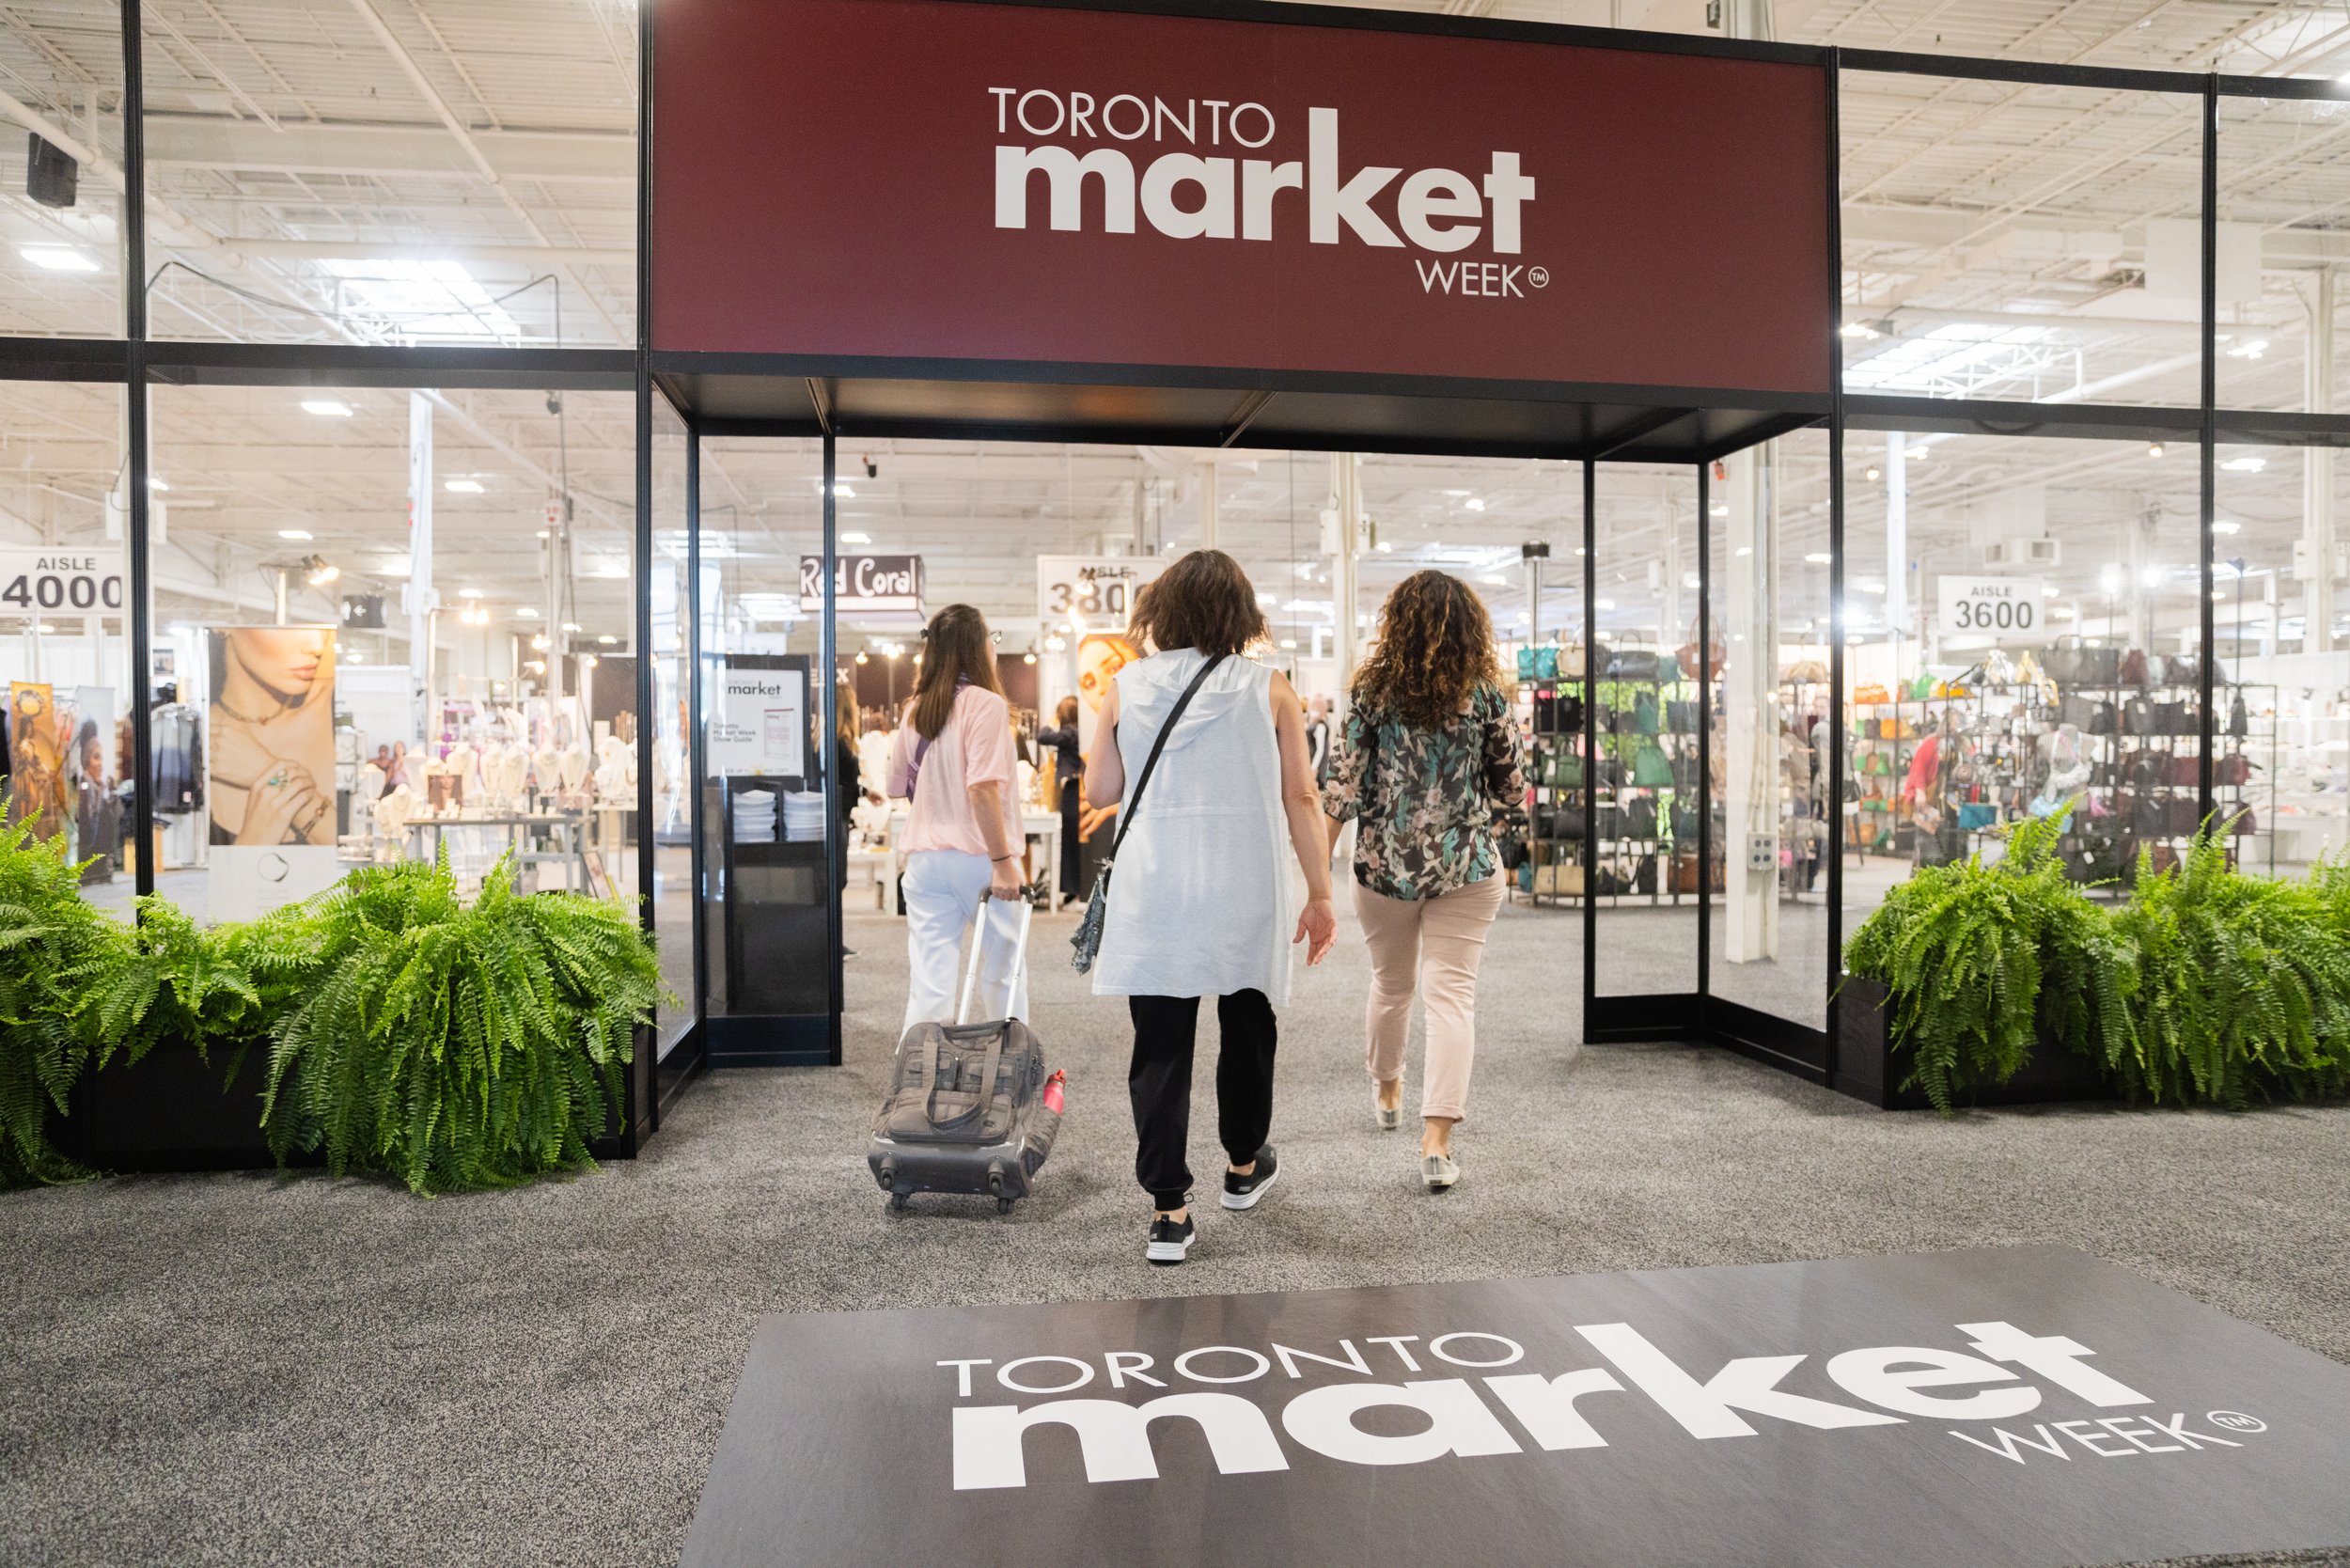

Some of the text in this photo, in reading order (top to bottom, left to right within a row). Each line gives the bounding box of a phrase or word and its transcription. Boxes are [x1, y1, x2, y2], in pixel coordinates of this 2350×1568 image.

[988, 86, 1276, 149] TORONTO
[995, 106, 1536, 254] market
[1415, 259, 1525, 298] WEEK
[37, 557, 96, 570] AISLE
[854, 557, 916, 597] Coral
[2, 574, 121, 608] 4000
[1971, 586, 2013, 597] AISLE
[1955, 601, 2032, 629] 3600
[728, 681, 781, 695] market
[936, 1332, 1525, 1398] TORONTO
[952, 1321, 2156, 1492] market
[1947, 1413, 2246, 1466] WEEK
